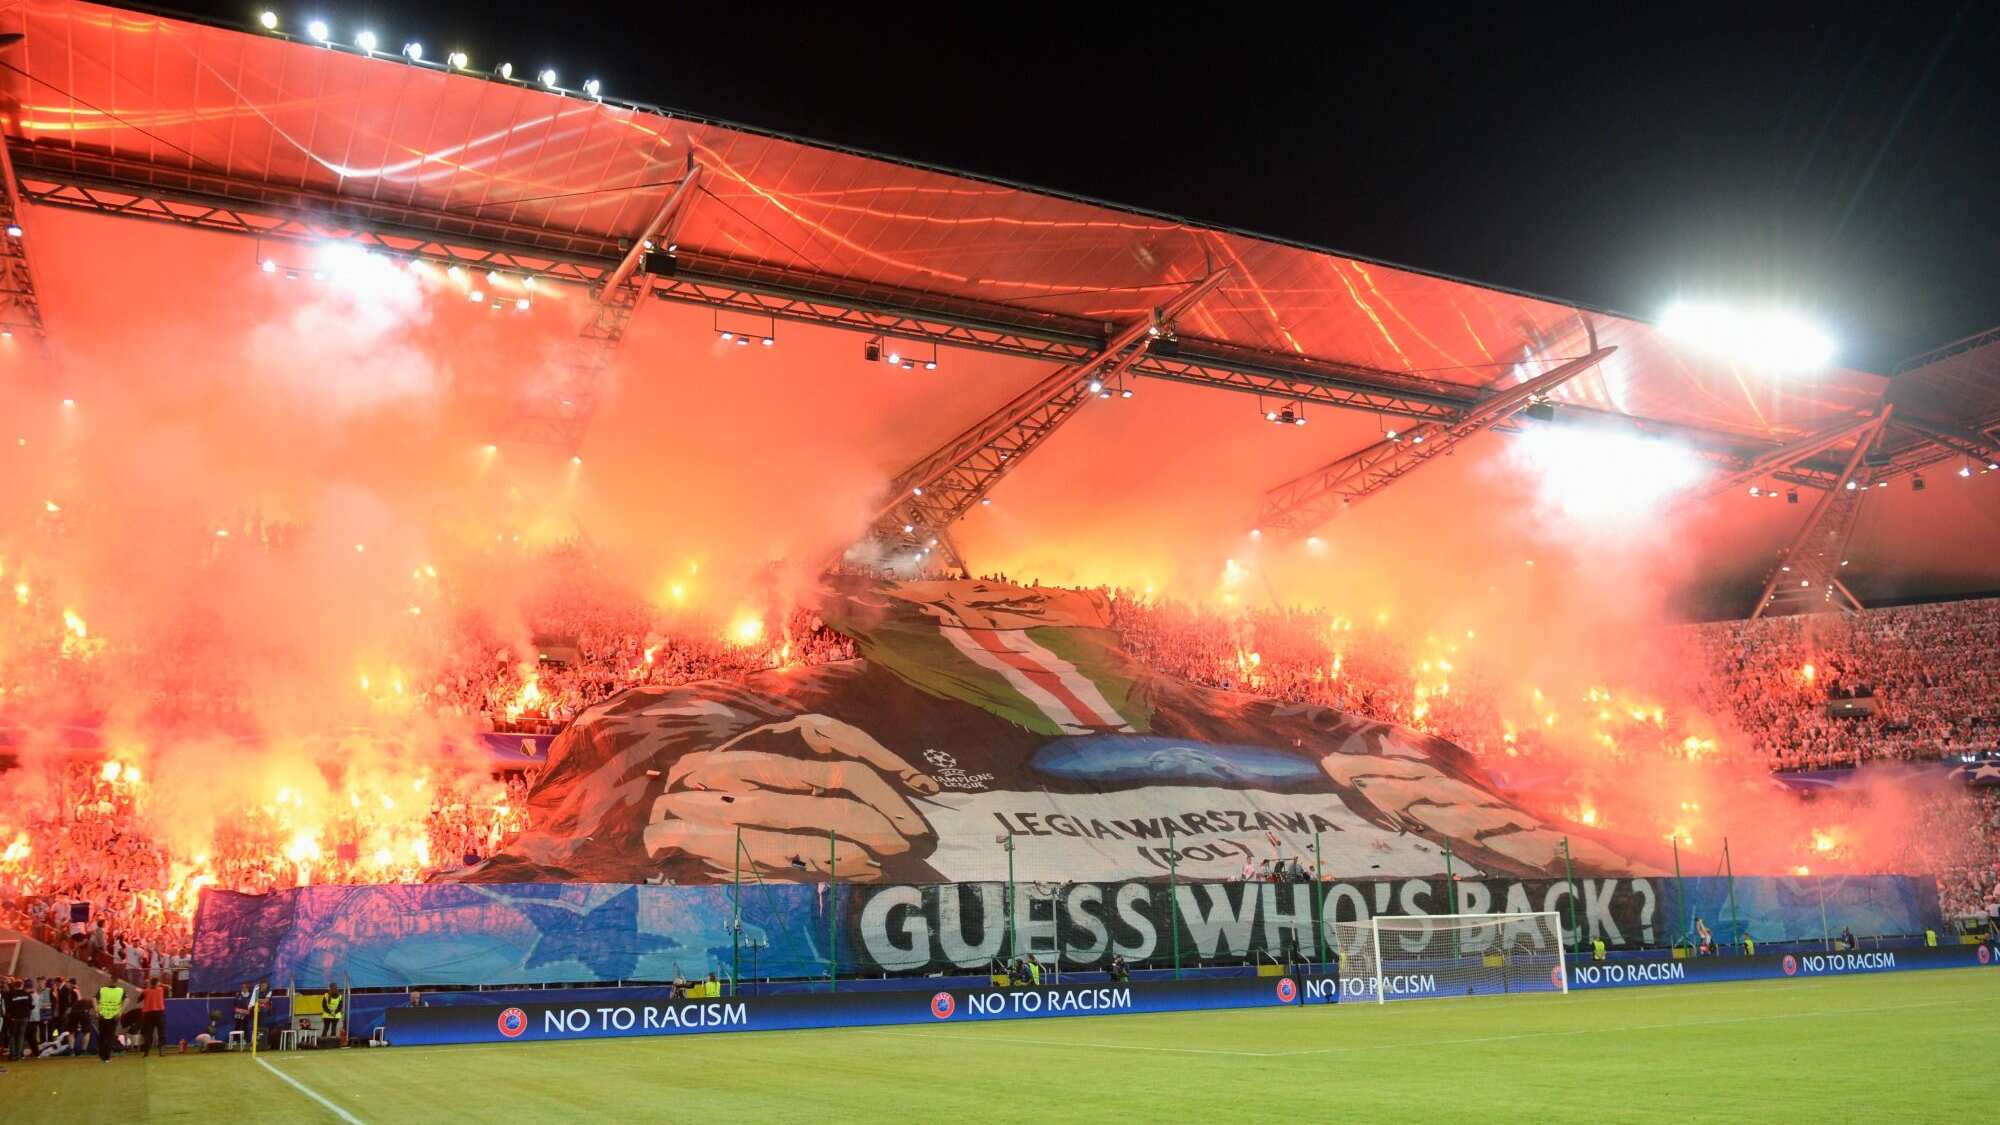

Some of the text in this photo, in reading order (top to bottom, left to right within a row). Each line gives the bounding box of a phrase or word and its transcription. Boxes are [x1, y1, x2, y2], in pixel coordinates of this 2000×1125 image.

[993, 809, 1345, 839] LEGIA WARSZAWA
[1137, 838, 1255, 870] (POL)
[860, 881, 1157, 972] GUESS
[1172, 879, 1433, 960] WHO'S
[1575, 962, 1685, 984] NO TO RACISM
[1803, 952, 1895, 972] NO TO RACISM
[968, 988, 1132, 1015] NO TO RACISM
[1306, 978, 1336, 998] NO
[1339, 977, 1364, 996] TO
[544, 1003, 748, 1033] NO TO RACISM
